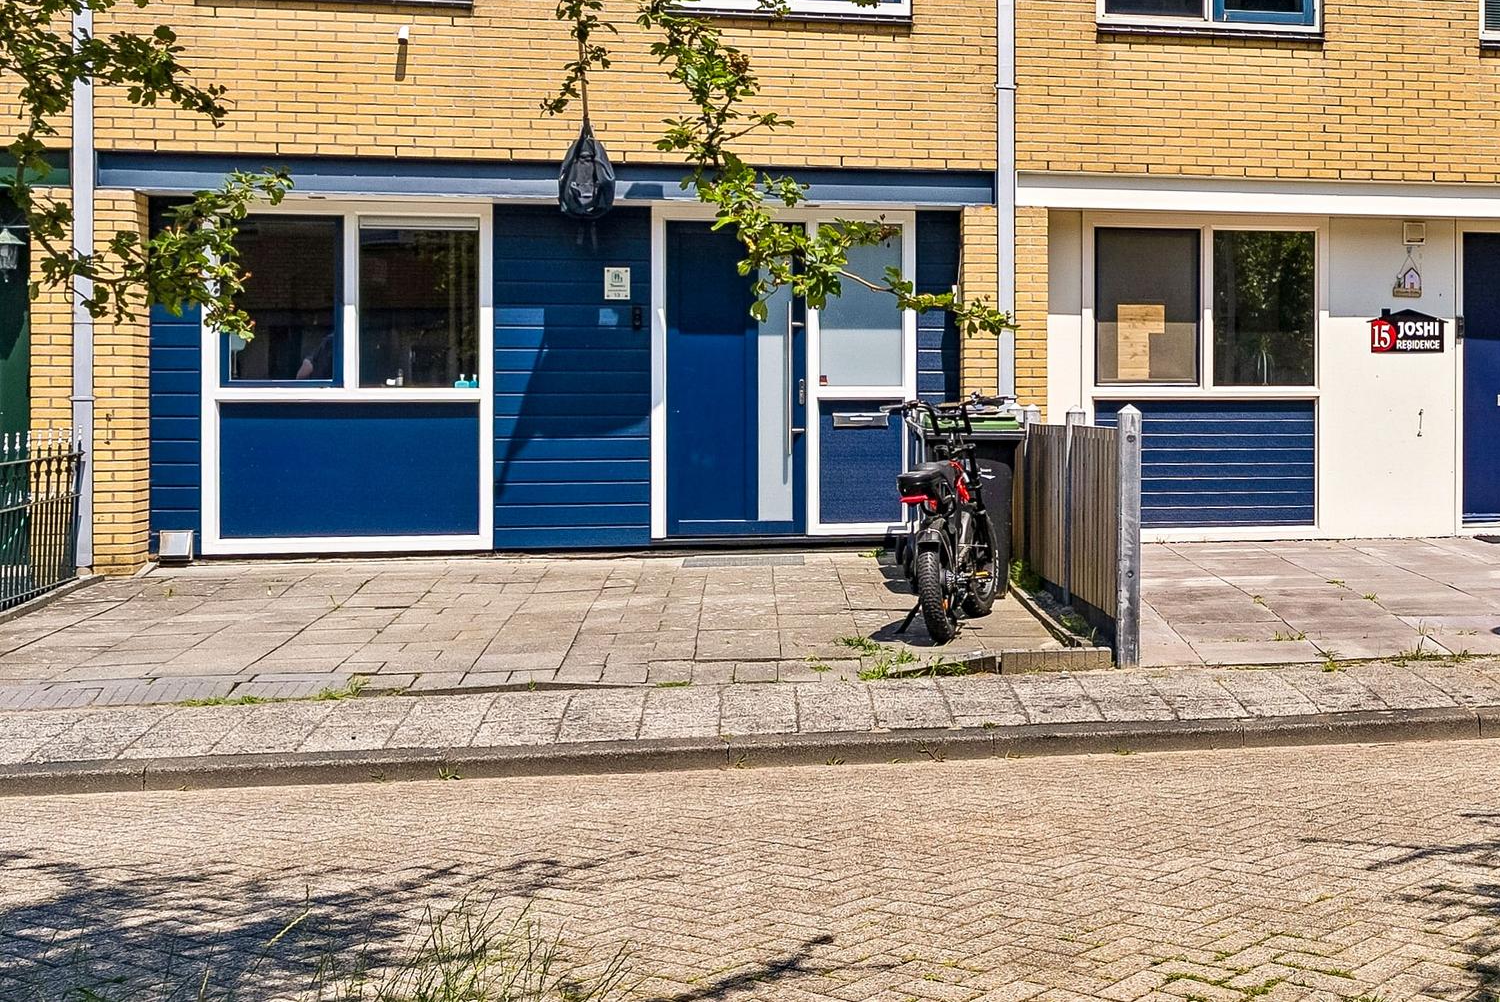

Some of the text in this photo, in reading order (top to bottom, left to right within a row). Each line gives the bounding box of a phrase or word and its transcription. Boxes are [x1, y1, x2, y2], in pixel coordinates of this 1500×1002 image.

[1372, 324, 1391, 348] 15
[1397, 321, 1440, 339] JOSHI
[1396, 339, 1440, 351] RESIDENCE
